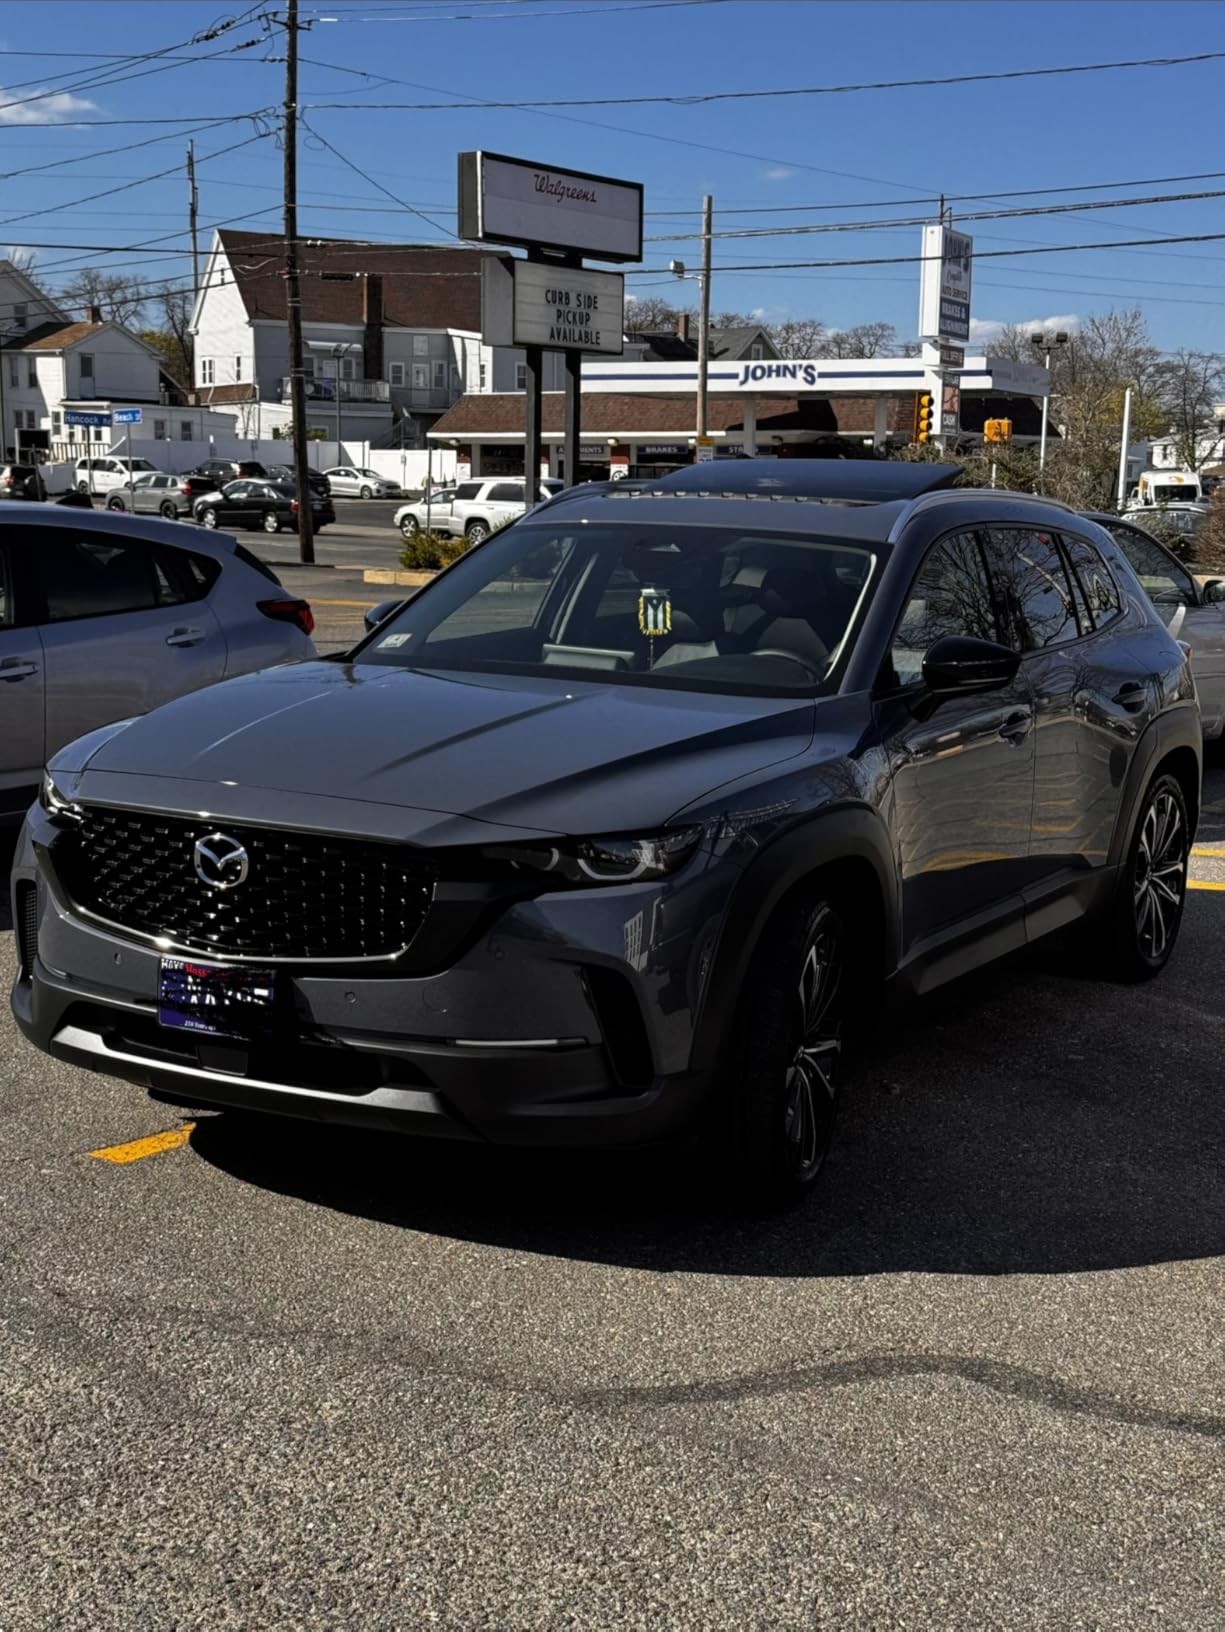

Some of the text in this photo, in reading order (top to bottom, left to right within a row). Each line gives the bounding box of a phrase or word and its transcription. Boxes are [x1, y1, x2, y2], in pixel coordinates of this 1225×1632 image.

[533, 173, 597, 203] Walgreens
[545, 288, 599, 310] CURB SIDE
[556, 308, 591, 327] PICKUP
[549, 325, 601, 346] AVAILABLE
[738, 362, 817, 386] JOHN'S
[65, 413, 98, 424] Hancock
[645, 446, 678, 454] BRAKES
